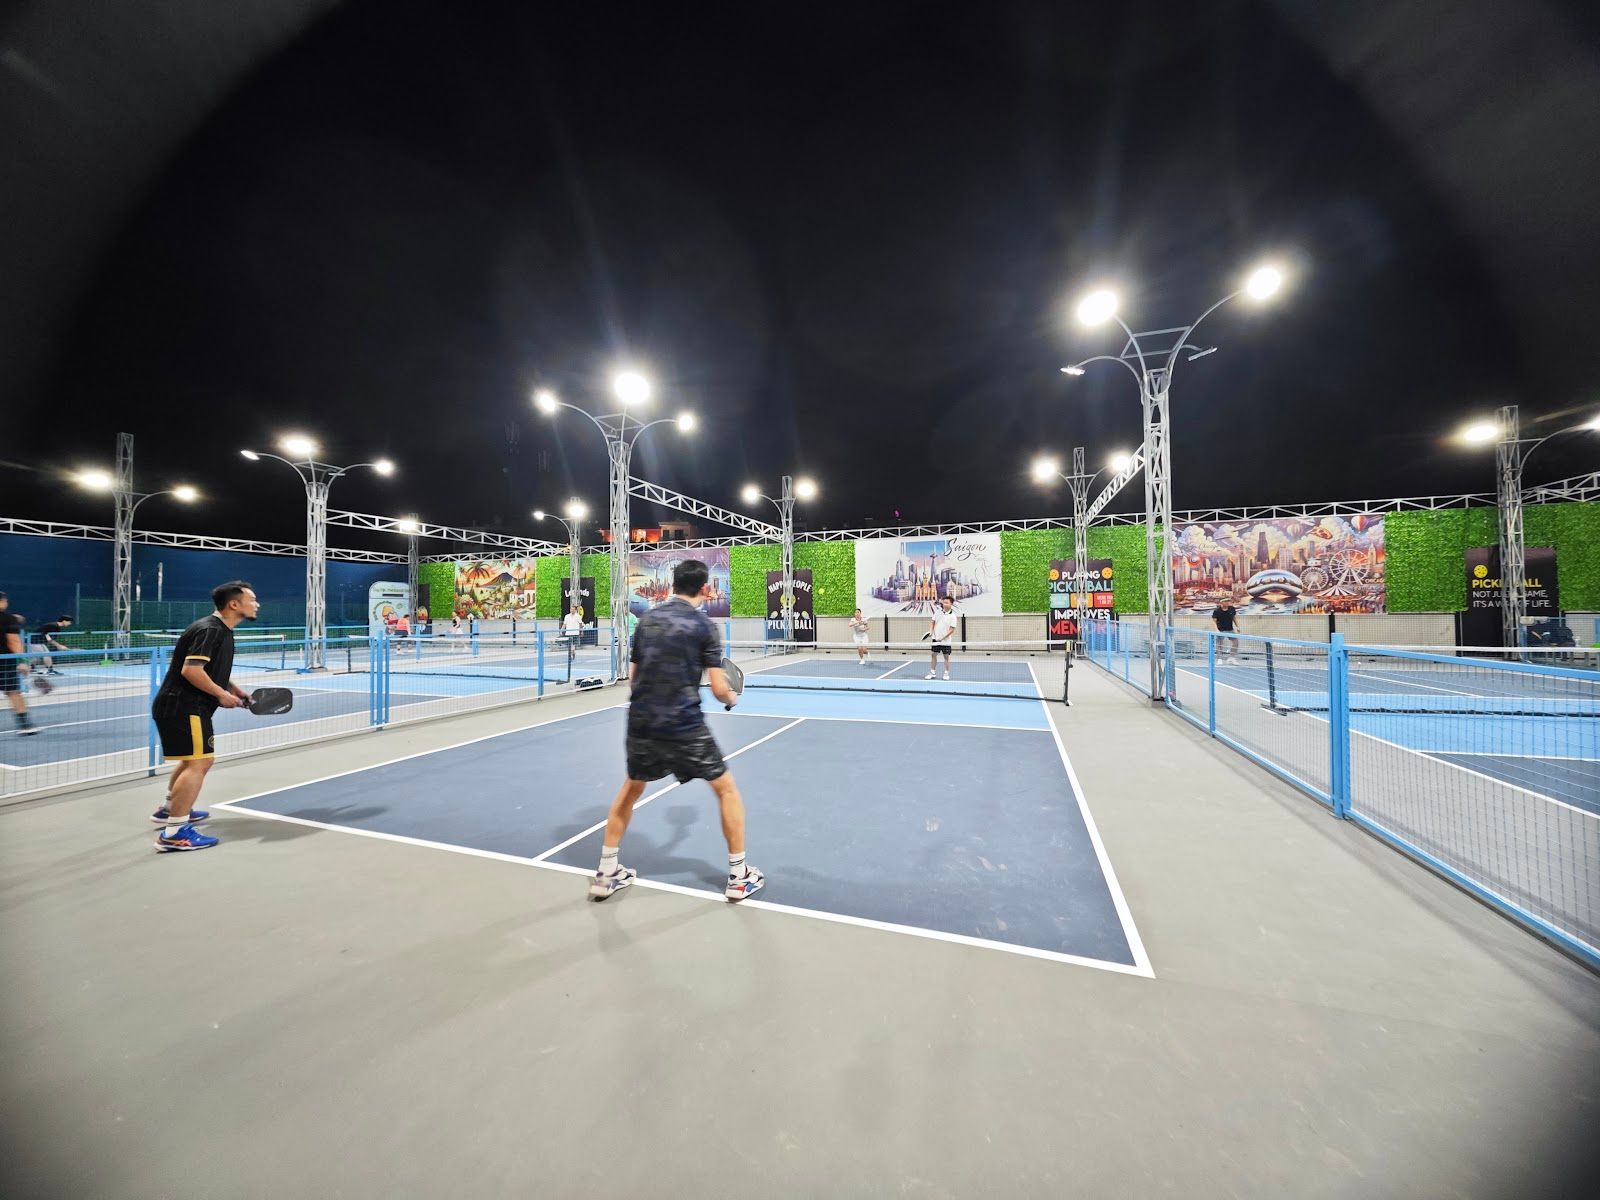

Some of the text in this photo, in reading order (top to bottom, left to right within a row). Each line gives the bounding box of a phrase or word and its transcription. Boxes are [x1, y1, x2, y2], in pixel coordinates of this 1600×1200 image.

[944, 537, 986, 561] Saigon
[1473, 590, 1491, 598] NOT
[1487, 600, 1495, 608] A
